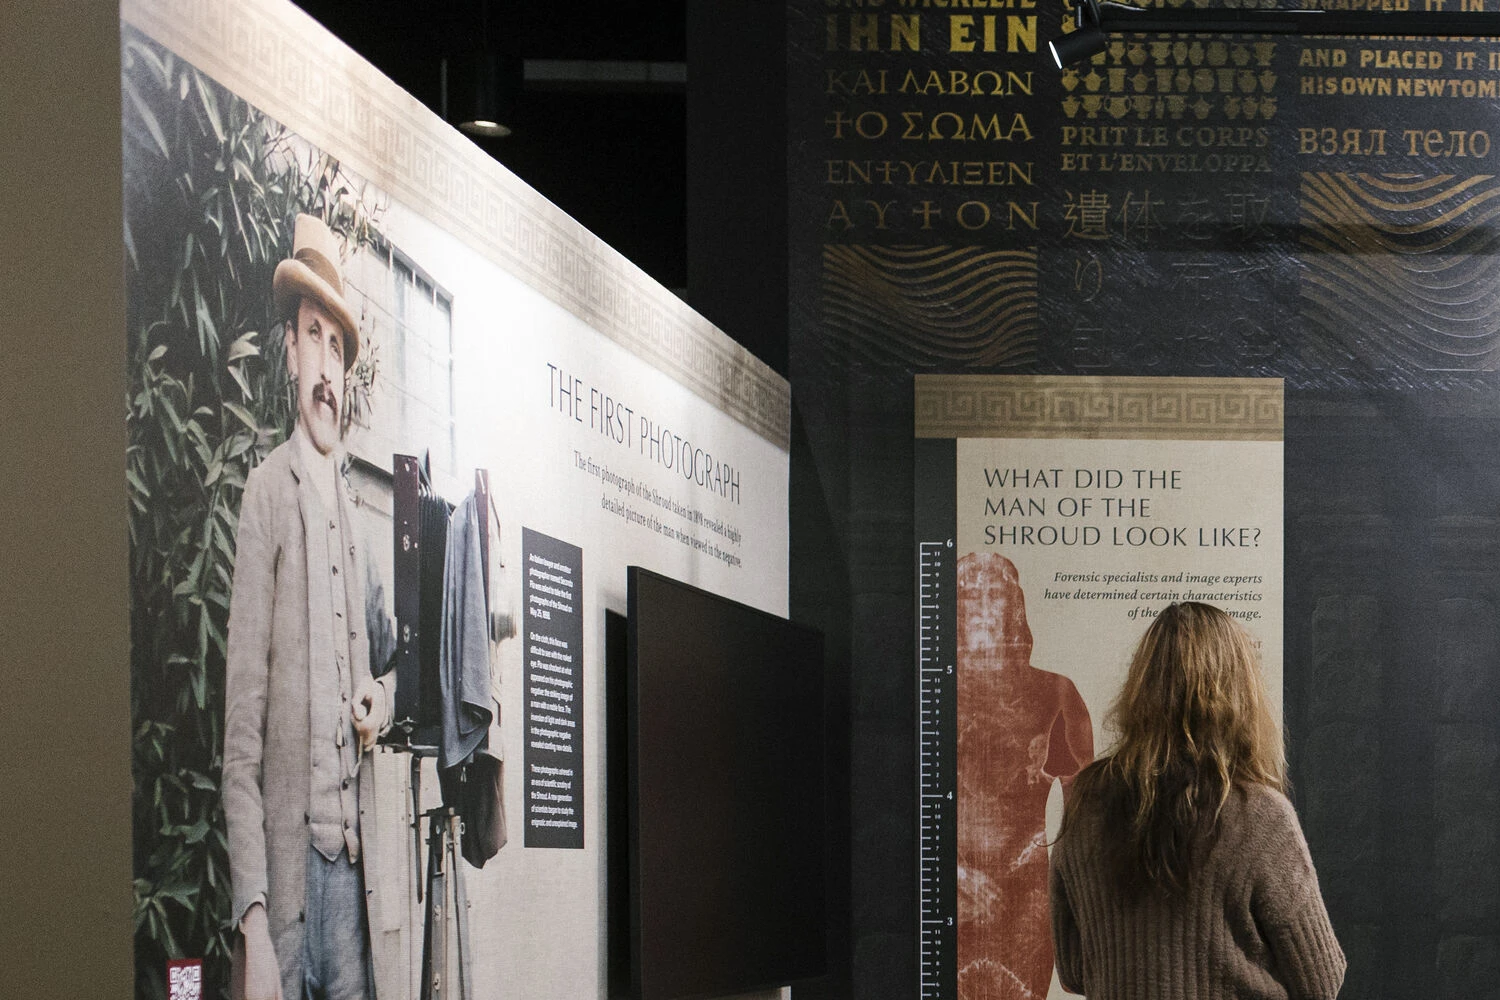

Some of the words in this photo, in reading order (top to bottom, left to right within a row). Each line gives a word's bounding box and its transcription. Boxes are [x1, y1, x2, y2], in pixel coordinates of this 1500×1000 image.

[950, 15, 1038, 53] EIN
[1300, 49, 1347, 68] AND
[1360, 50, 1443, 69] PLACED
[1455, 52, 1477, 70] IT
[1341, 78, 1392, 96] OWN
[1397, 78, 1445, 97] NEW
[1061, 127, 1128, 146] PRIT
[1134, 127, 1169, 147] LE
[1175, 127, 1270, 148] CORPS
[1299, 127, 1387, 155] взял
[1403, 129, 1491, 158] тело
[1061, 153, 1092, 171] ET
[547, 362, 583, 423] THE
[591, 387, 634, 448] FIRST
[640, 416, 741, 505] PHOTOGRAPH
[573, 449, 587, 471] The
[983, 468, 1064, 489] WHAT
[1075, 469, 1123, 489] DID
[1131, 469, 1182, 490] THE
[984, 497, 1046, 517] MAN
[1057, 497, 1093, 518] OF
[1100, 497, 1151, 518] THE
[946, 538, 954, 548] 6
[984, 525, 1101, 546] SHROUD
[1113, 526, 1187, 547] LOOK
[1199, 527, 1261, 548] LIKE?
[1053, 571, 1101, 583] Forensic
[1102, 571, 1159, 586] specialists
[1160, 572, 1184, 583] and
[1185, 572, 1221, 587] image
[1222, 575, 1263, 587] experts
[1044, 589, 1071, 601] have
[1073, 589, 1138, 601] determined
[1140, 590, 1180, 601] certain
[1182, 591, 1262, 602] characteristics
[1127, 608, 1139, 621] of
[1140, 609, 1159, 620] the
[1224, 608, 1262, 621] image.
[946, 665, 953, 675] 5
[946, 791, 953, 801] 4
[946, 916, 953, 926] 3
